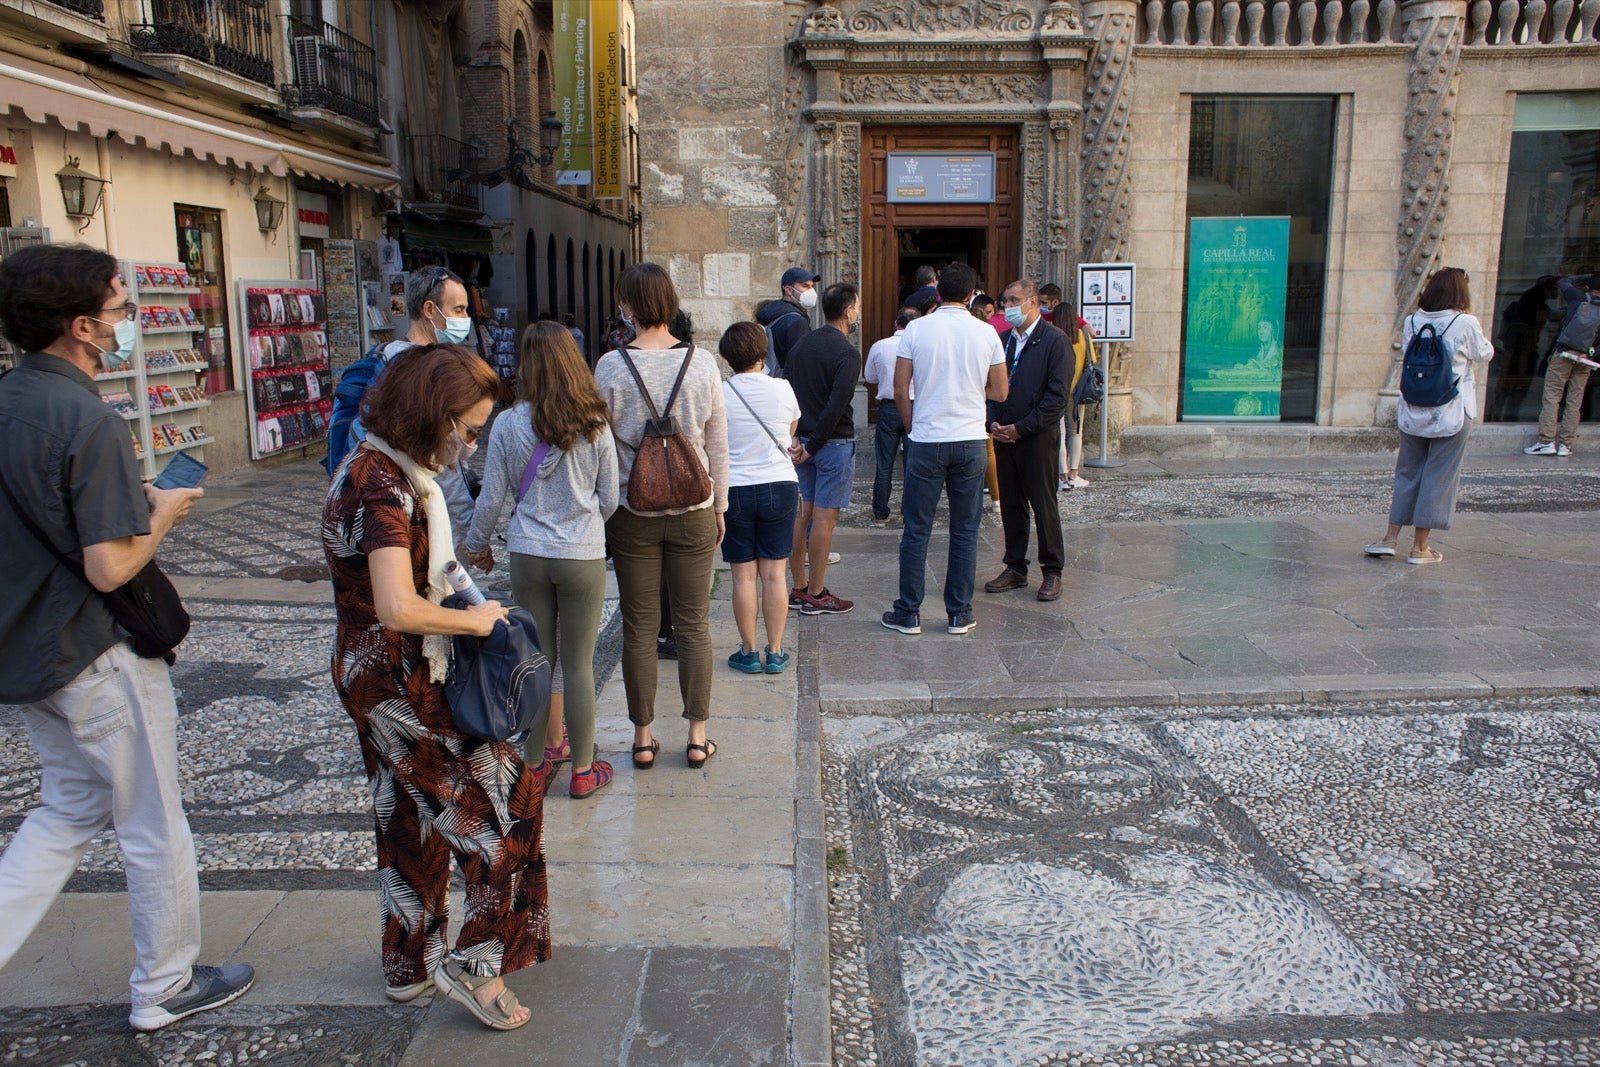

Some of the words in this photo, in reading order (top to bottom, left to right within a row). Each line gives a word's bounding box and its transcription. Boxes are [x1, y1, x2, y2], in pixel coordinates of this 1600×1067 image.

[575, 18, 586, 62] Painting
[576, 66, 585, 76] of
[607, 31, 616, 85] Collection
[576, 79, 585, 111] Limits
[596, 71, 606, 119] Guerrero
[608, 88, 616, 109] The
[562, 96, 571, 135] Teixidor
[576, 113, 585, 134] The
[598, 121, 606, 147] José
[608, 120, 617, 170] colección
[562, 139, 571, 164] Jordi
[597, 149, 607, 185] Centro
[609, 172, 618, 185] La
[1203, 248, 1246, 257] CAPILLA
[1248, 248, 1276, 256] REAL
